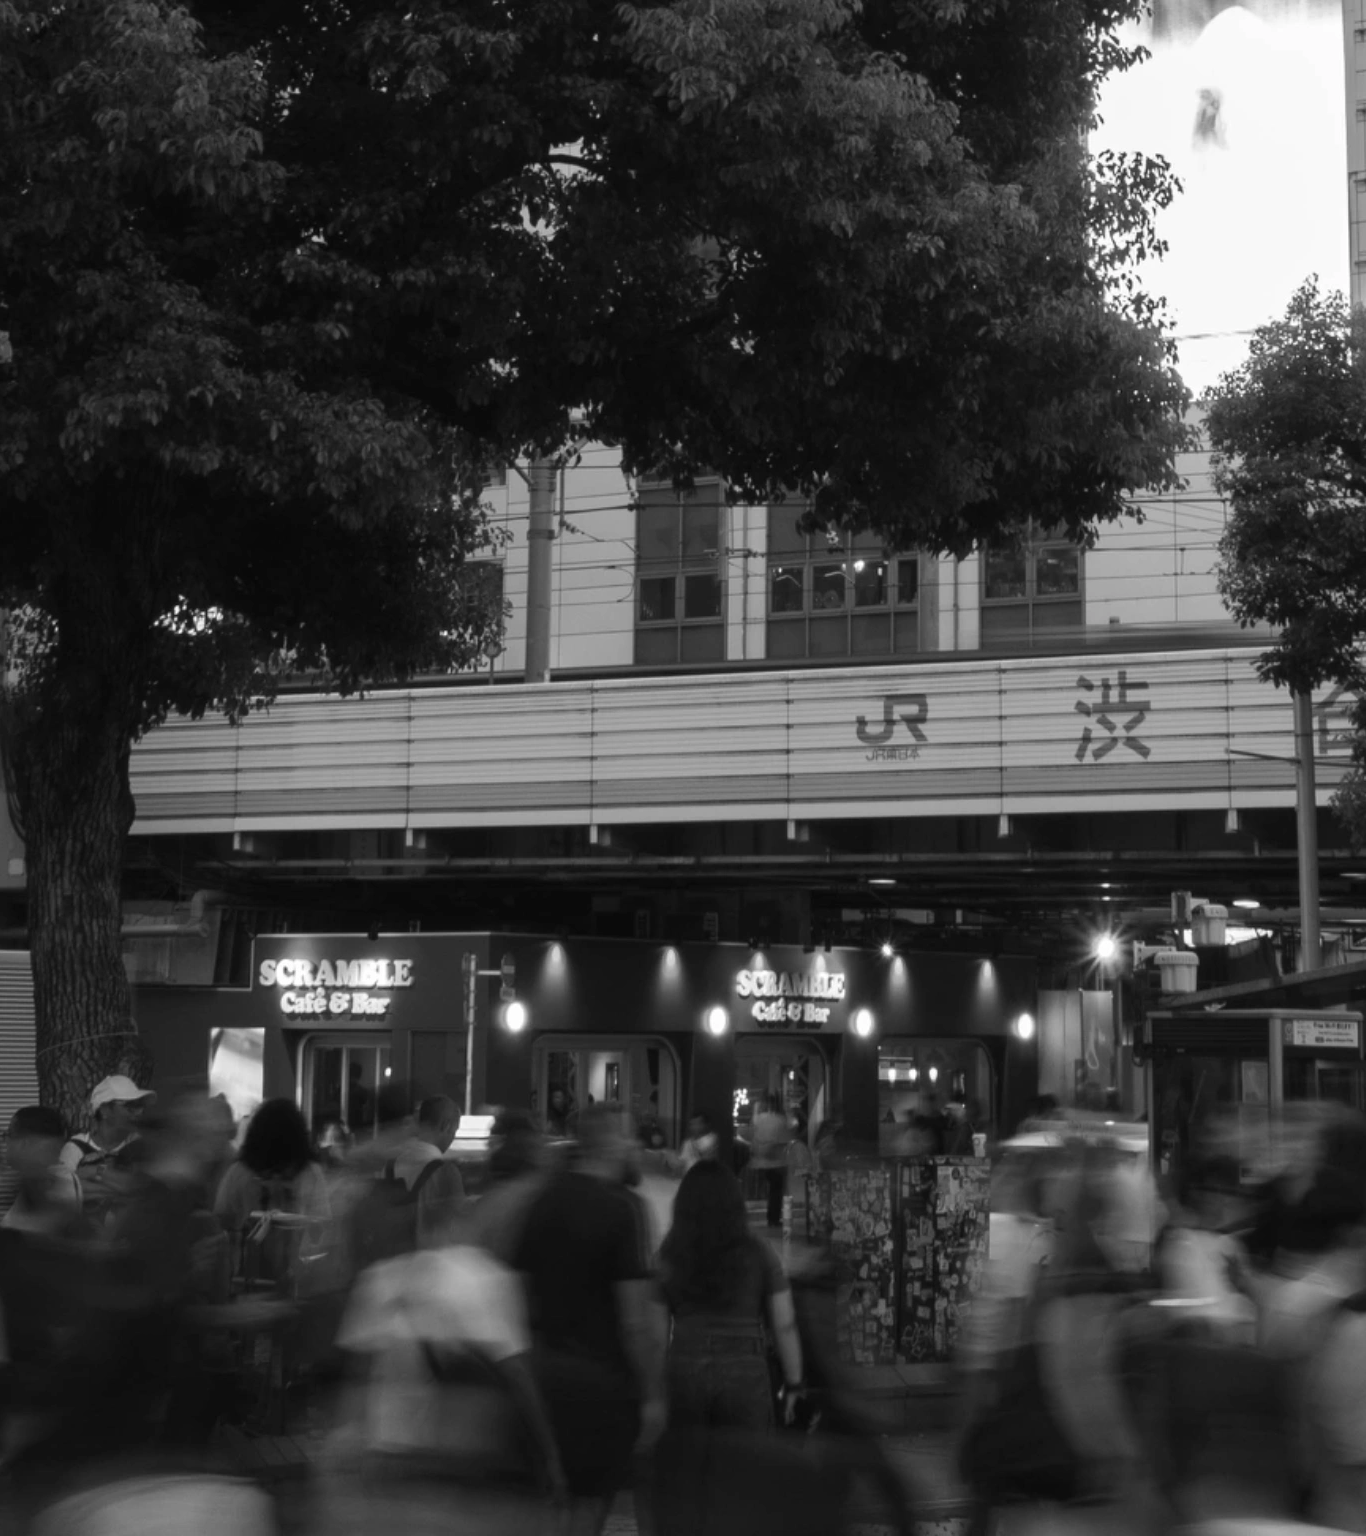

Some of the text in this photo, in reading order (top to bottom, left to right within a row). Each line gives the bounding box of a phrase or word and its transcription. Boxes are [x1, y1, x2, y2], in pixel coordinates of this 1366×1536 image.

[856, 693, 929, 745] JR
[259, 958, 414, 987] SCRAMBLE
[736, 969, 846, 999] SCRAMBLE
[351, 992, 391, 1014] Bar
[803, 1002, 831, 1023] Bar
